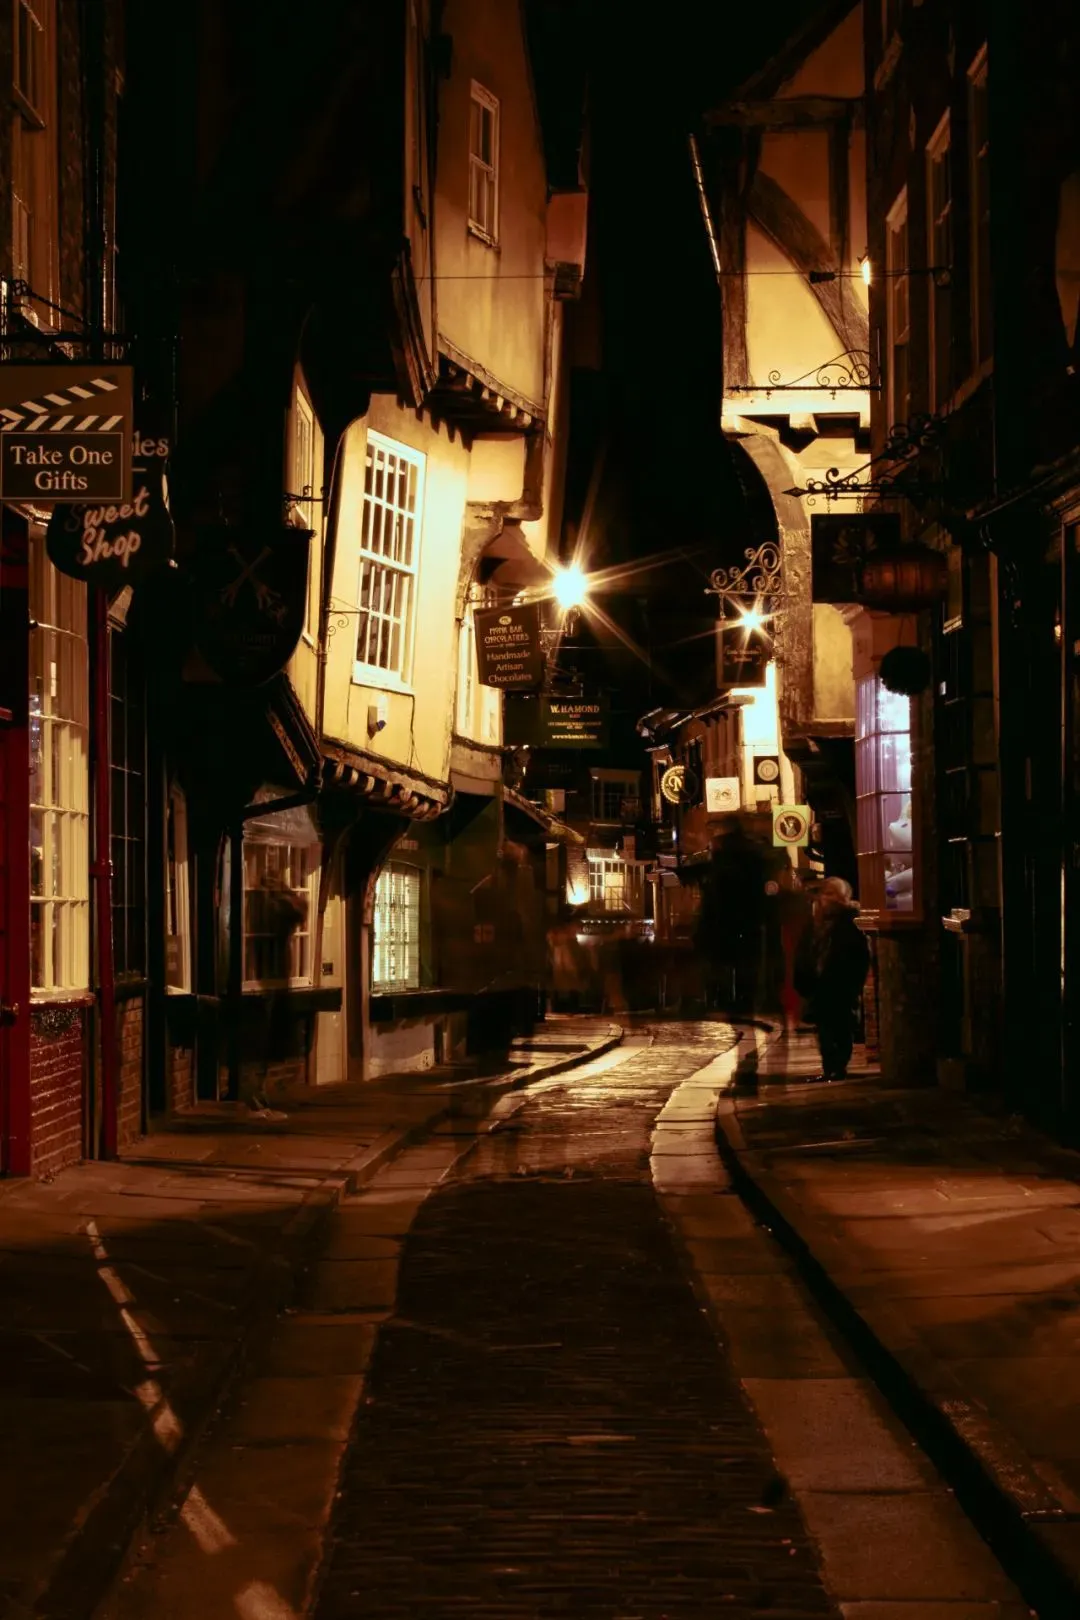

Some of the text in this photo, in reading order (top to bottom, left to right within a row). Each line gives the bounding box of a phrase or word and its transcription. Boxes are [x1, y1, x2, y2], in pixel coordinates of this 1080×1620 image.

[131, 430, 169, 457] les
[10, 445, 114, 465] Take One
[34, 471, 88, 491] Gifts
[64, 486, 150, 532] Sweet
[79, 530, 141, 567] Shop
[489, 624, 523, 636] MONK BAR
[486, 650, 531, 662] Handmade
[495, 663, 524, 672] Artisan
[488, 673, 533, 684] Chocolates
